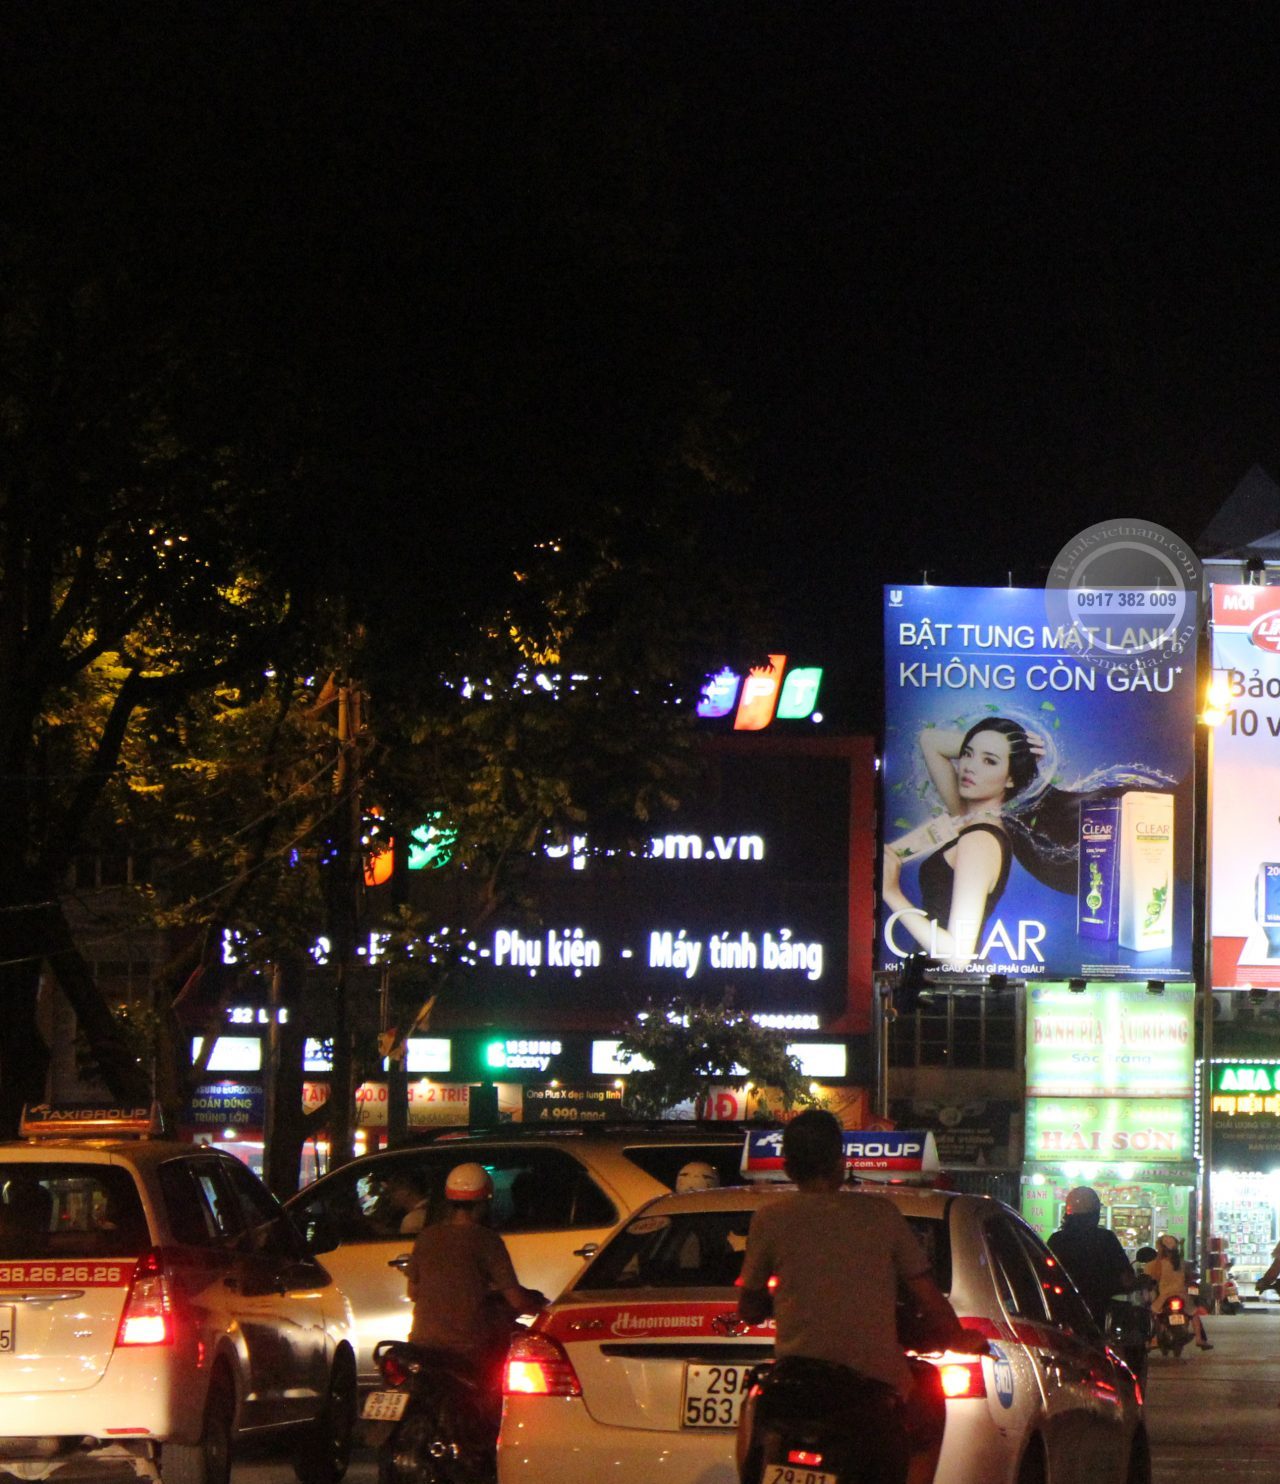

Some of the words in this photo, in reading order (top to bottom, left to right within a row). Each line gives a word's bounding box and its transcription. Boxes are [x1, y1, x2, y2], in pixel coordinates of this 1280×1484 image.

[899, 617, 952, 650] BẬT
[957, 624, 1035, 648] TUNG
[1042, 621, 1100, 649] MÁT
[1106, 627, 1179, 655] LẠNH
[900, 657, 1016, 690] KHÔNG
[1026, 660, 1095, 691] CÒN
[1227, 709, 1258, 737] 10
[1082, 823, 1112, 834] CLEAR
[1136, 822, 1169, 834] CLEAR
[884, 908, 1046, 962] CLEAR
[495, 930, 541, 977] Phụ
[548, 928, 600, 977] kiện
[650, 929, 701, 978] Máy
[710, 931, 757, 968] tính
[763, 928, 823, 980] bảng
[441, 1084, 468, 1106] TRIỆ
[41, 1108, 148, 1120] TAXIGROUP
[1112, 1128, 1176, 1151] SƠN
